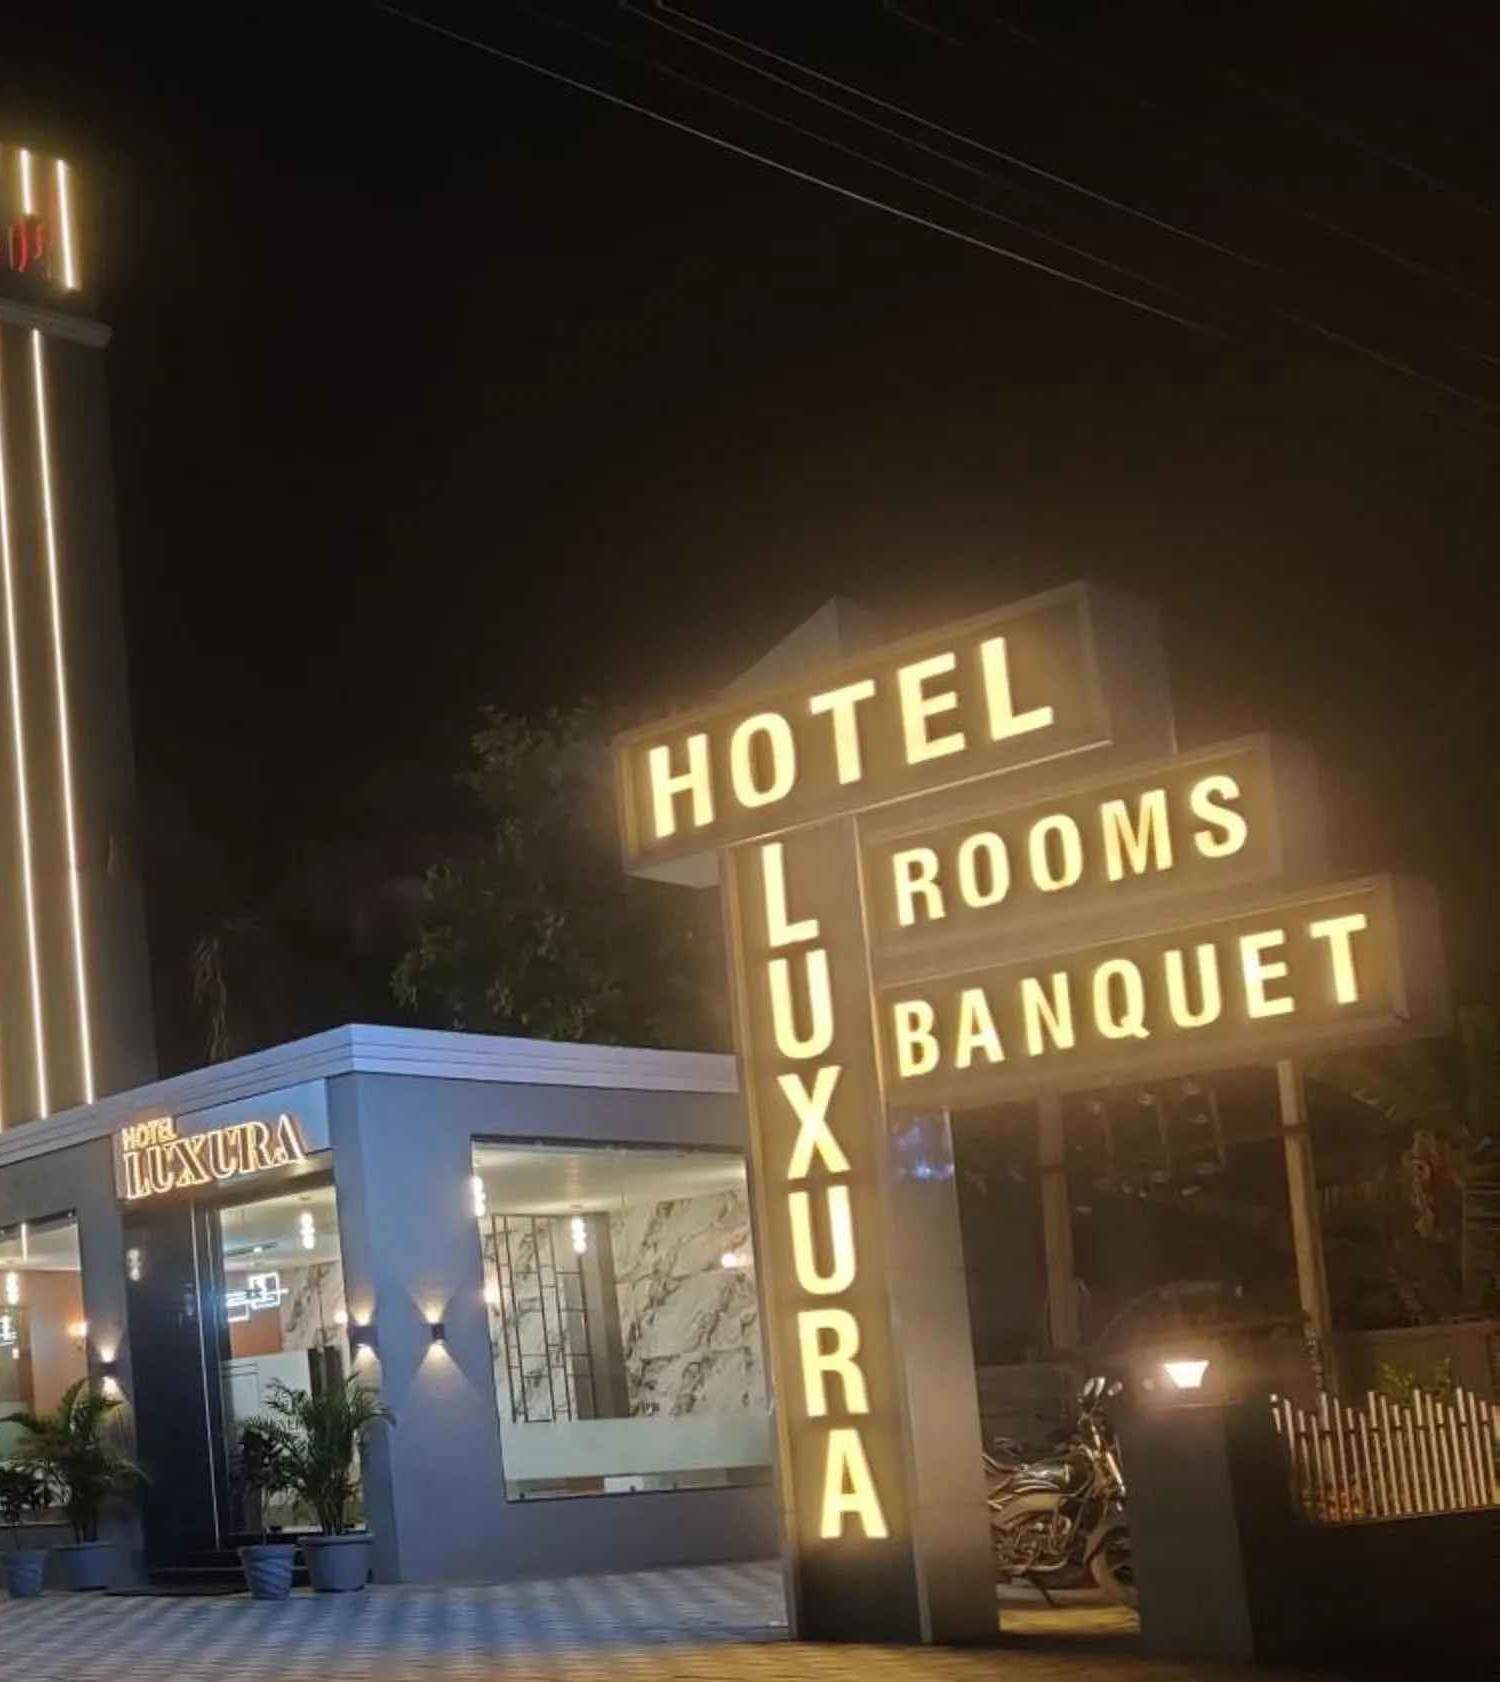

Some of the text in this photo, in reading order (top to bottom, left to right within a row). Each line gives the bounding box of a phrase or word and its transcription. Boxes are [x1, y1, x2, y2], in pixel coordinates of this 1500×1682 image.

[647, 636, 1054, 839] HOTEL
[892, 774, 1248, 928] ROOMS
[894, 913, 1367, 1078] BANQUET
[122, 1116, 177, 1150] HOTEL
[123, 1113, 308, 1200] LUXURA
[762, 842, 890, 1540] LUXURA
